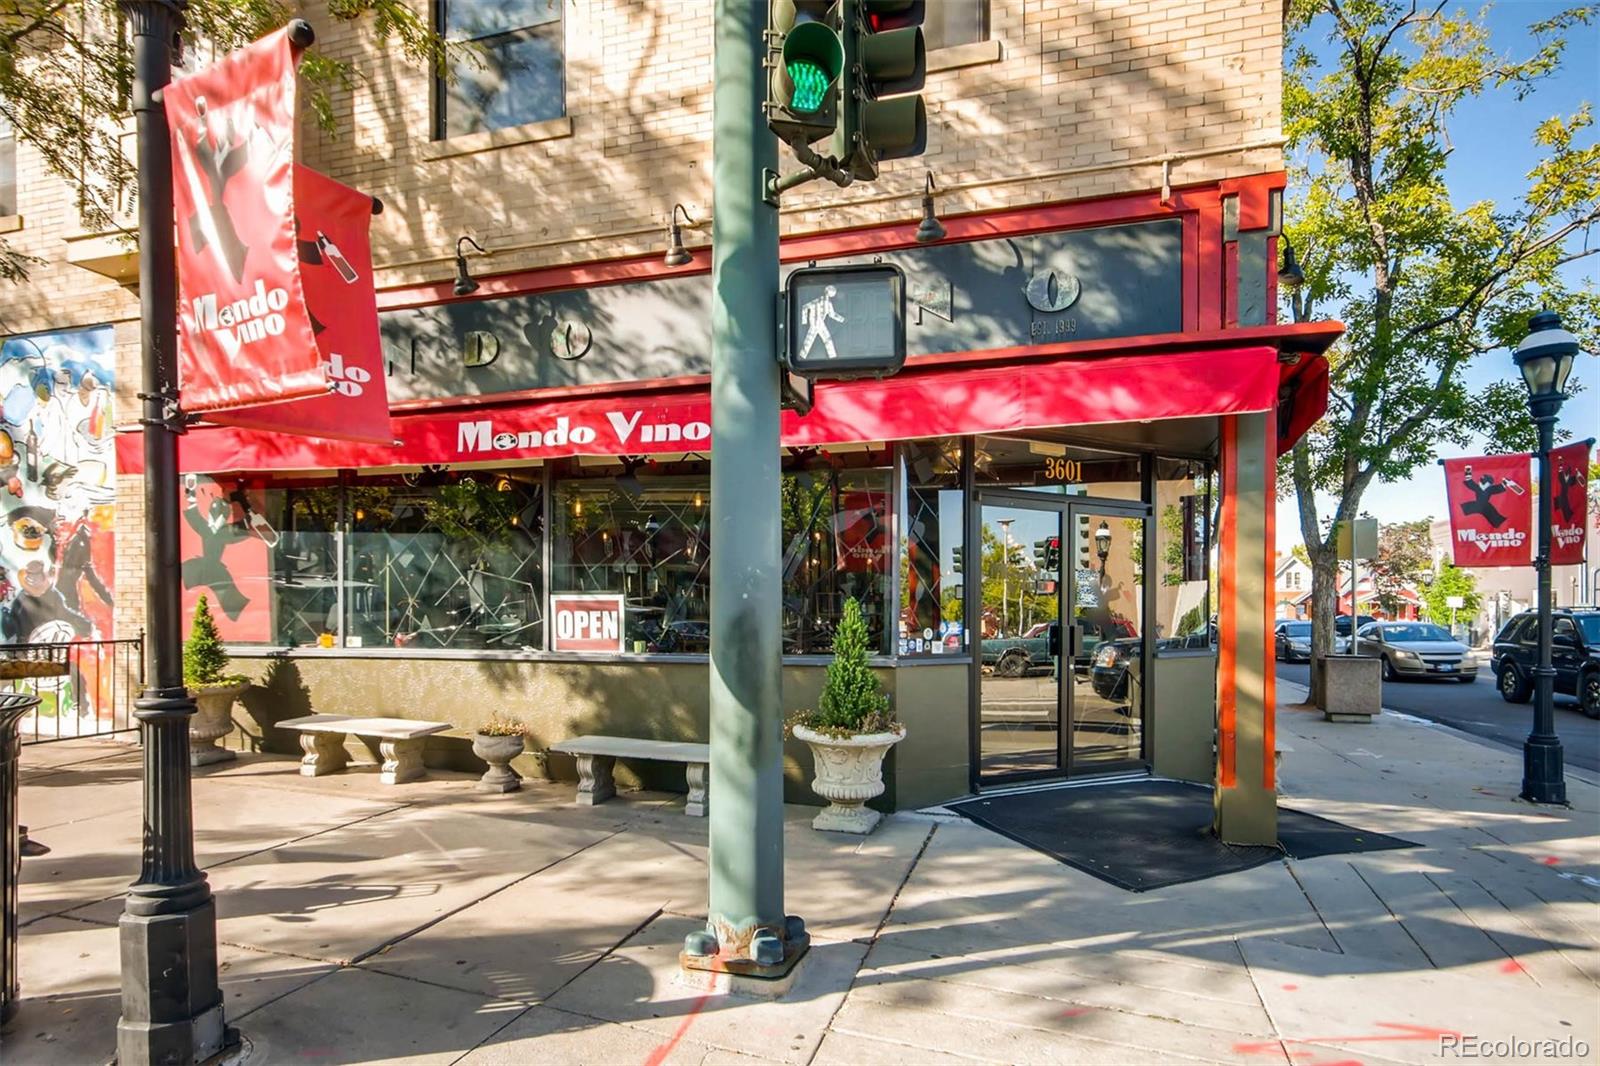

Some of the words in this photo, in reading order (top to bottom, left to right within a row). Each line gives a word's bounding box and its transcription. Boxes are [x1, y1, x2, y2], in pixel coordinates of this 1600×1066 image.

[192, 278, 289, 334] Mondo
[214, 313, 287, 362] Vino
[457, 416, 597, 454] Mondo
[606, 410, 711, 445] Vino
[1045, 456, 1083, 482] 3601
[1456, 527, 1527, 542] Mondo
[1475, 539, 1522, 553] Vino
[557, 610, 619, 640] OPEN
